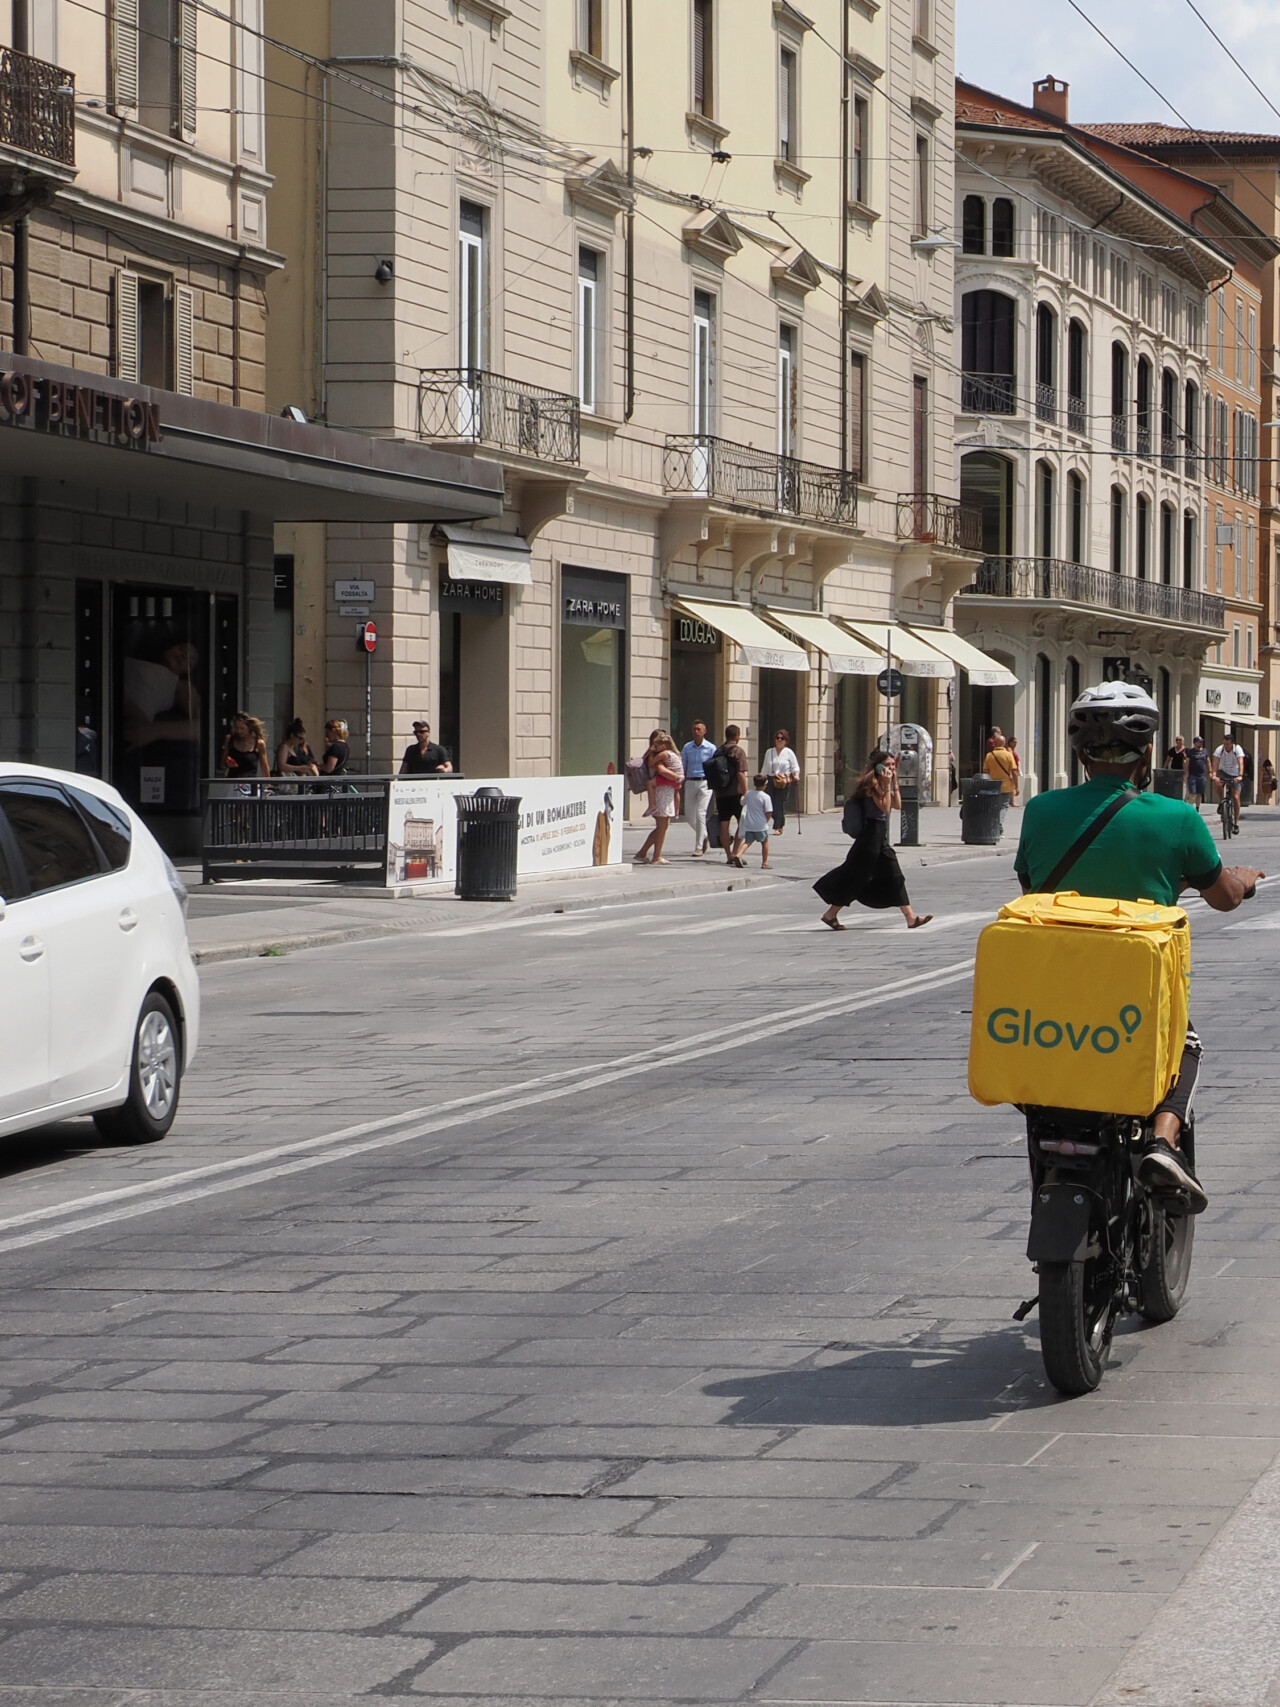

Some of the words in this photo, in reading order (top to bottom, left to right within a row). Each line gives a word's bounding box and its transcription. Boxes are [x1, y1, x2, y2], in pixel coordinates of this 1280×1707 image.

[1, 370, 40, 417] OF
[442, 582, 470, 598] ZARA
[474, 585, 502, 601] HOME
[570, 599, 594, 613] ZARA
[597, 601, 621, 616] HOME
[680, 619, 717, 645] DOUGLAS
[526, 812, 533, 828] DI
[536, 810, 545, 825] UN
[547, 800, 586, 823] ROMANZIERE
[987, 1007, 1120, 1054] Glovo
